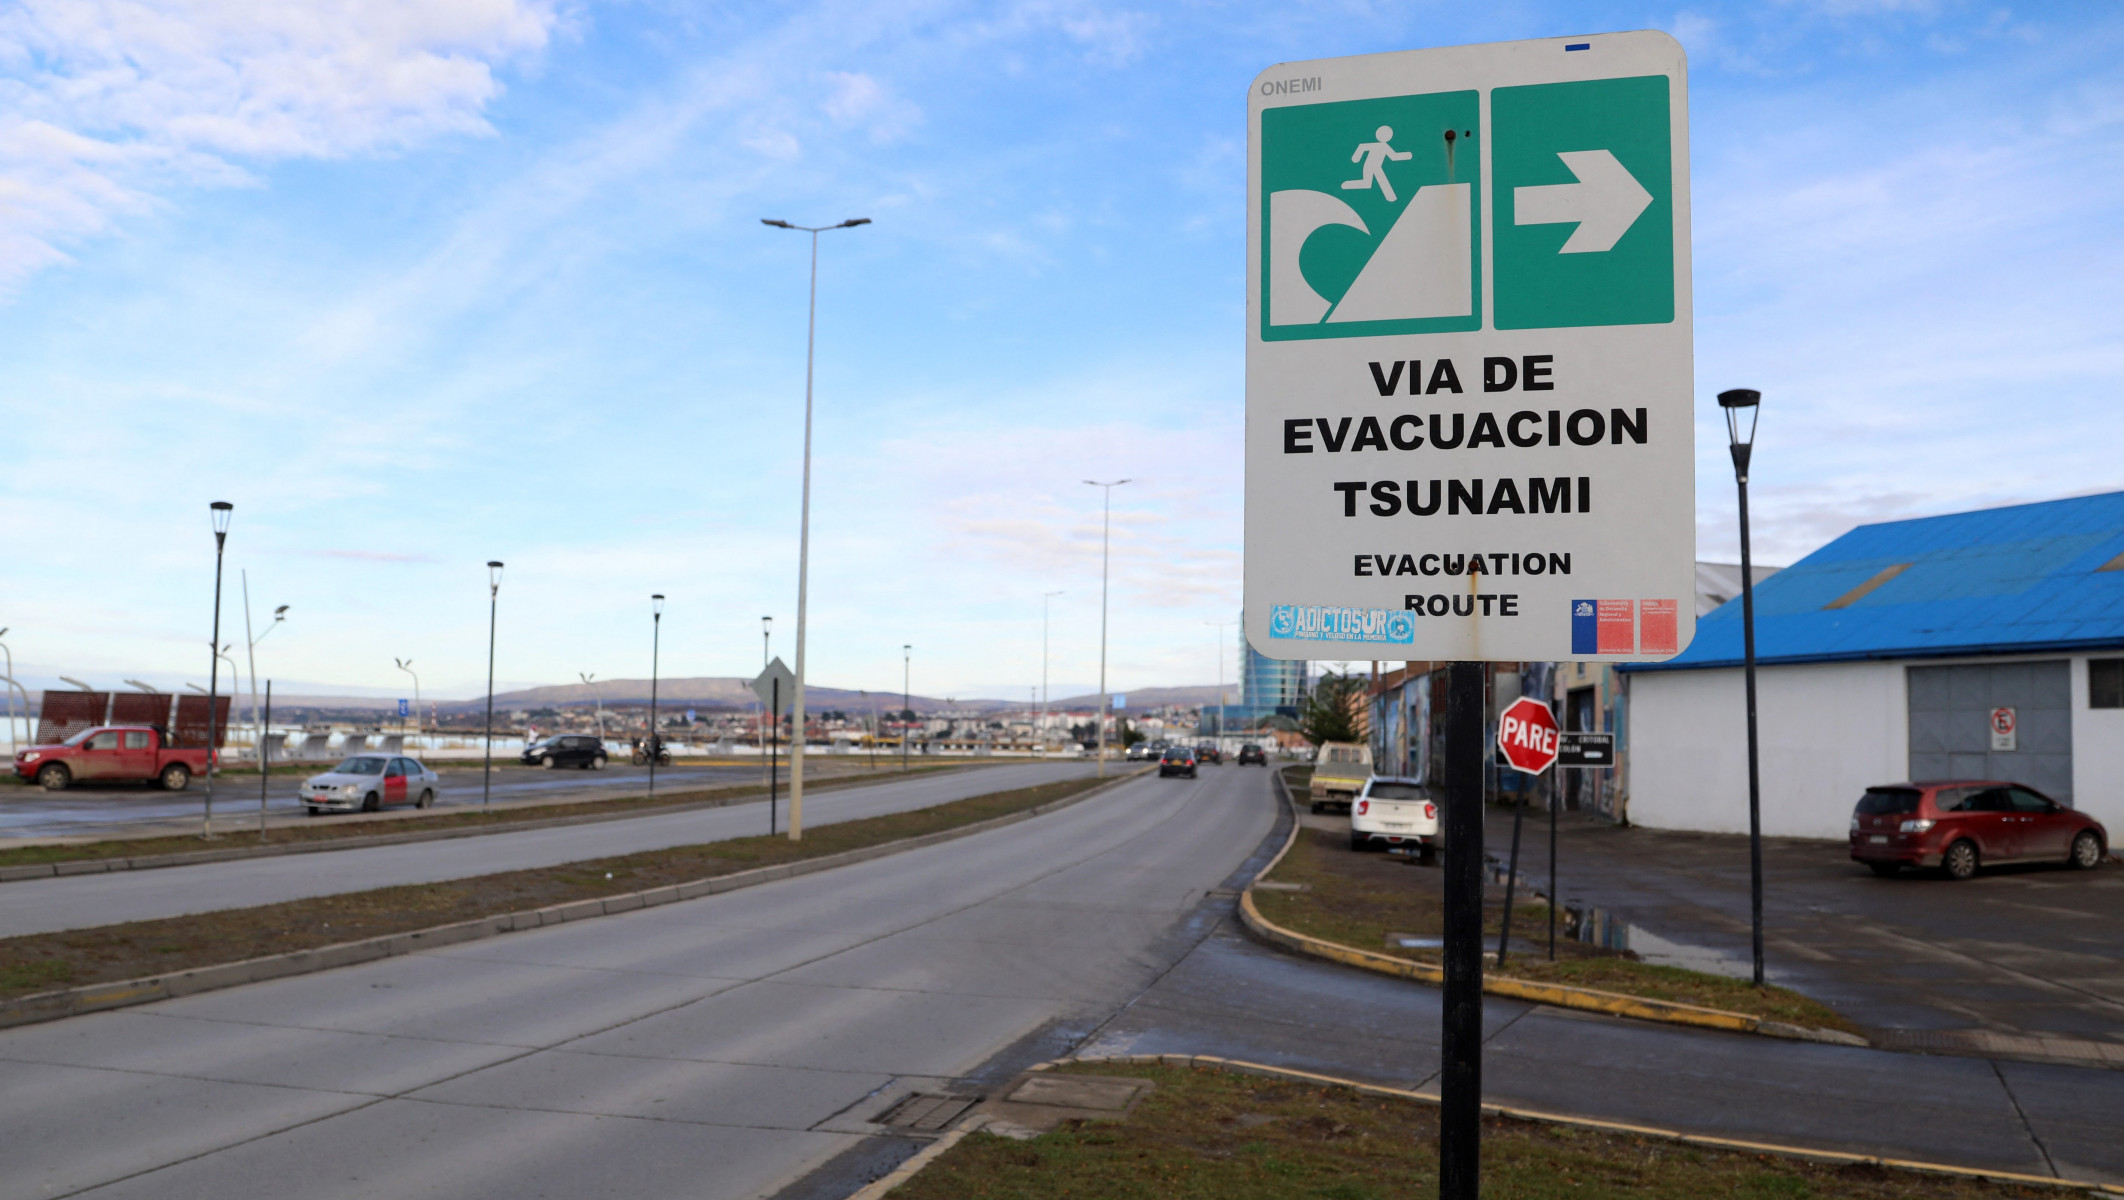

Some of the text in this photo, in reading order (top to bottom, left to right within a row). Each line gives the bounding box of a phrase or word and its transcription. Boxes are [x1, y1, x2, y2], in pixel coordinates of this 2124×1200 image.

[1261, 76, 1322, 96] ONEMI
[1368, 354, 1555, 397] VIA DE
[1283, 407, 1648, 454] EVACUACION
[1333, 476, 1591, 517] TSUNAMI
[1353, 552, 1571, 577] EVACUATION
[1296, 607, 1387, 635] ADICTOSUR
[1404, 594, 1519, 617] ROUTE
[1503, 716, 1556, 755] PARE
